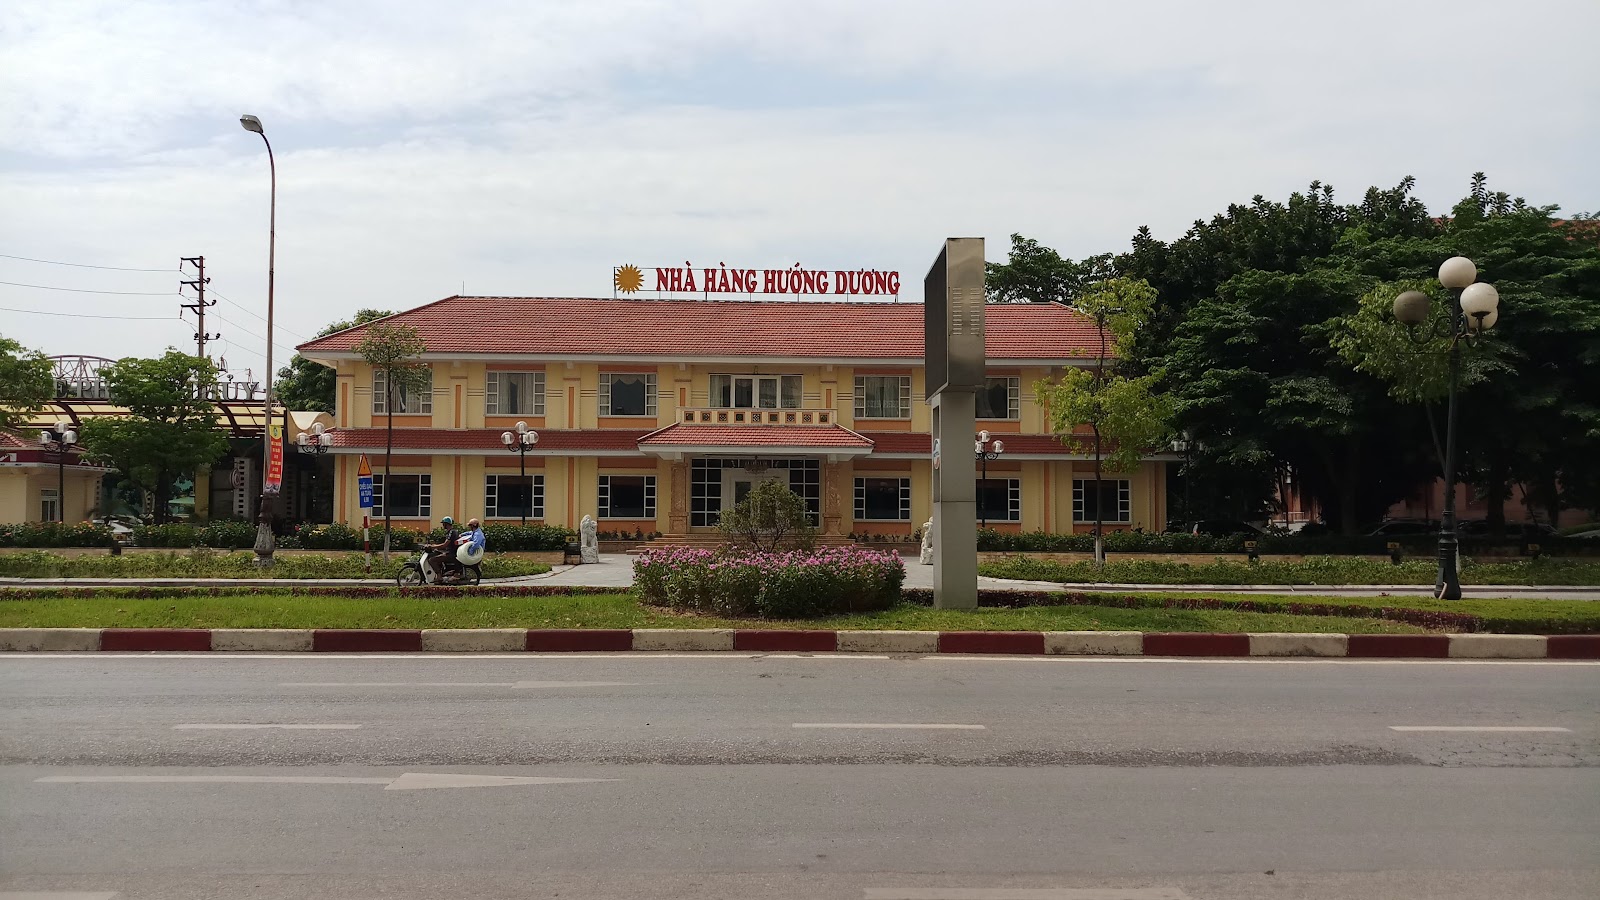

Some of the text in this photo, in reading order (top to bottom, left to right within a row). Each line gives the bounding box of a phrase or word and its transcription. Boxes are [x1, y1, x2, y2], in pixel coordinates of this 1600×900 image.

[656, 261, 900, 295] NHÀ HÀNG HƯỚNG DƯƠNG
